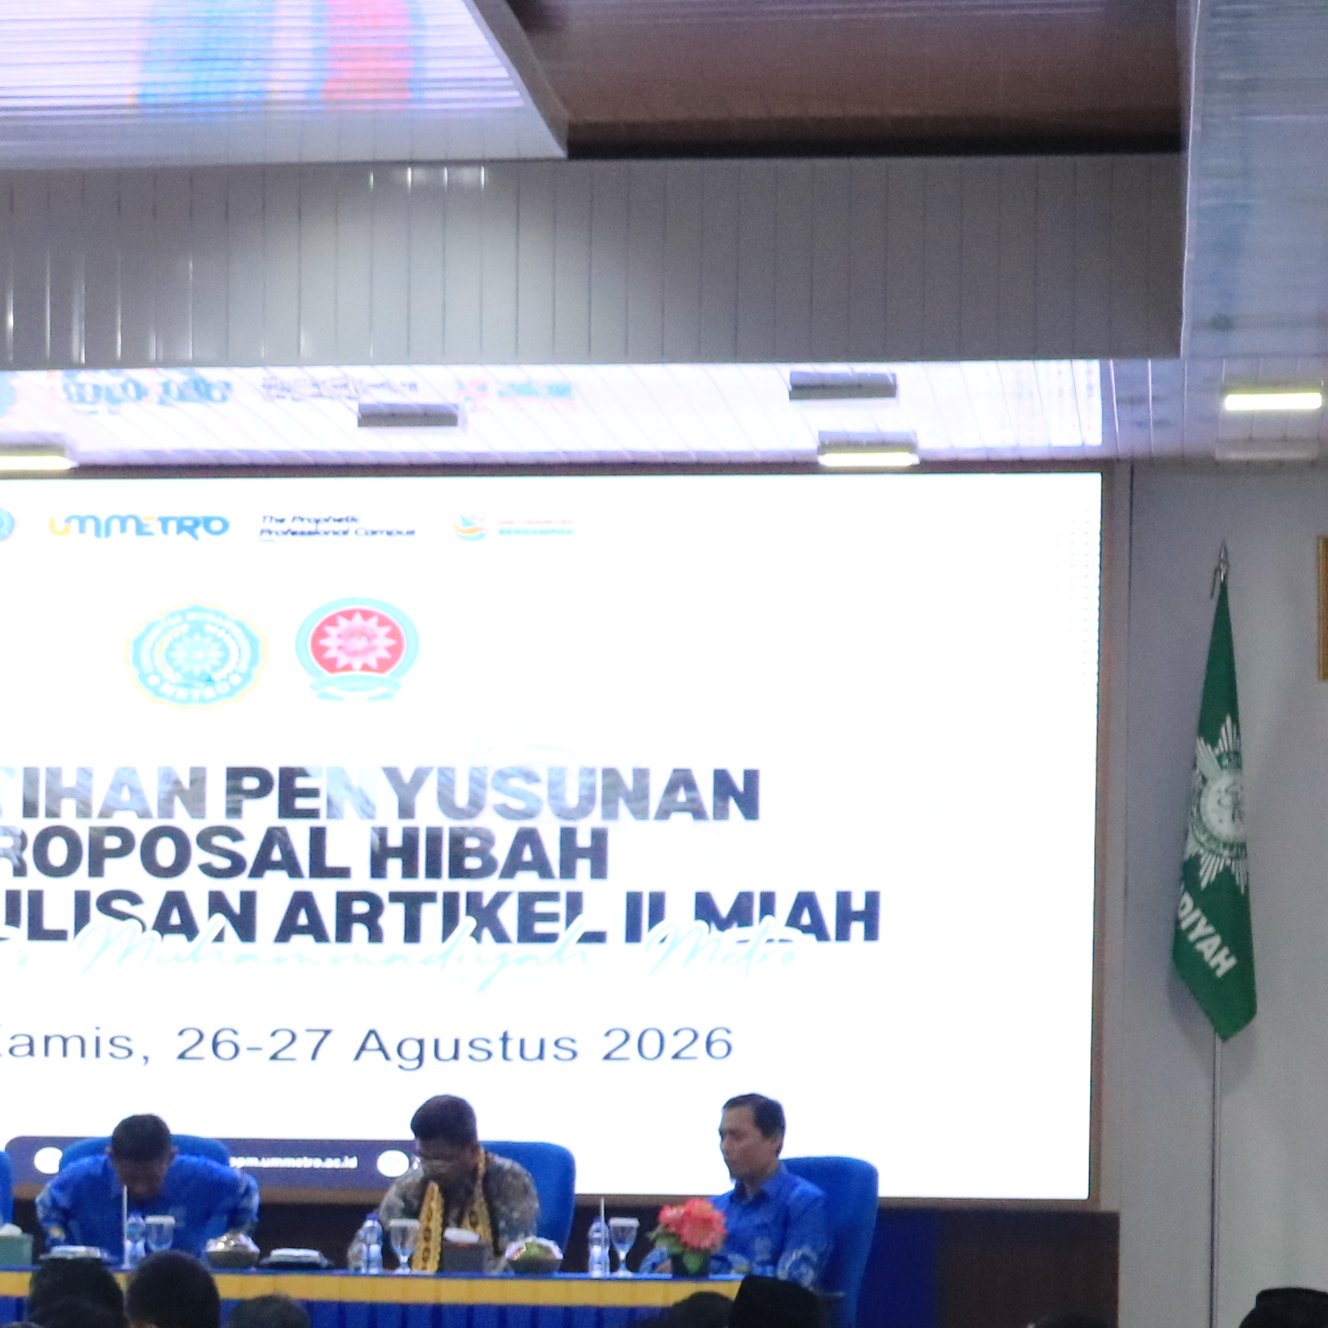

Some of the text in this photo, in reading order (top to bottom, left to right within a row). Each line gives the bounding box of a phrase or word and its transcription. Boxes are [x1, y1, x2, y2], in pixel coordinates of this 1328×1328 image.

[261, 514, 286, 525] The
[225, 766, 761, 822] PENYUSUNAN
[369, 826, 609, 880] HIBAH
[274, 890, 608, 944] ARTIKEL
[1178, 884, 1238, 978] DIYAH
[176, 1027, 333, 1062] 26-27
[352, 1027, 580, 1072] Agustus
[601, 1026, 734, 1062] 2026
